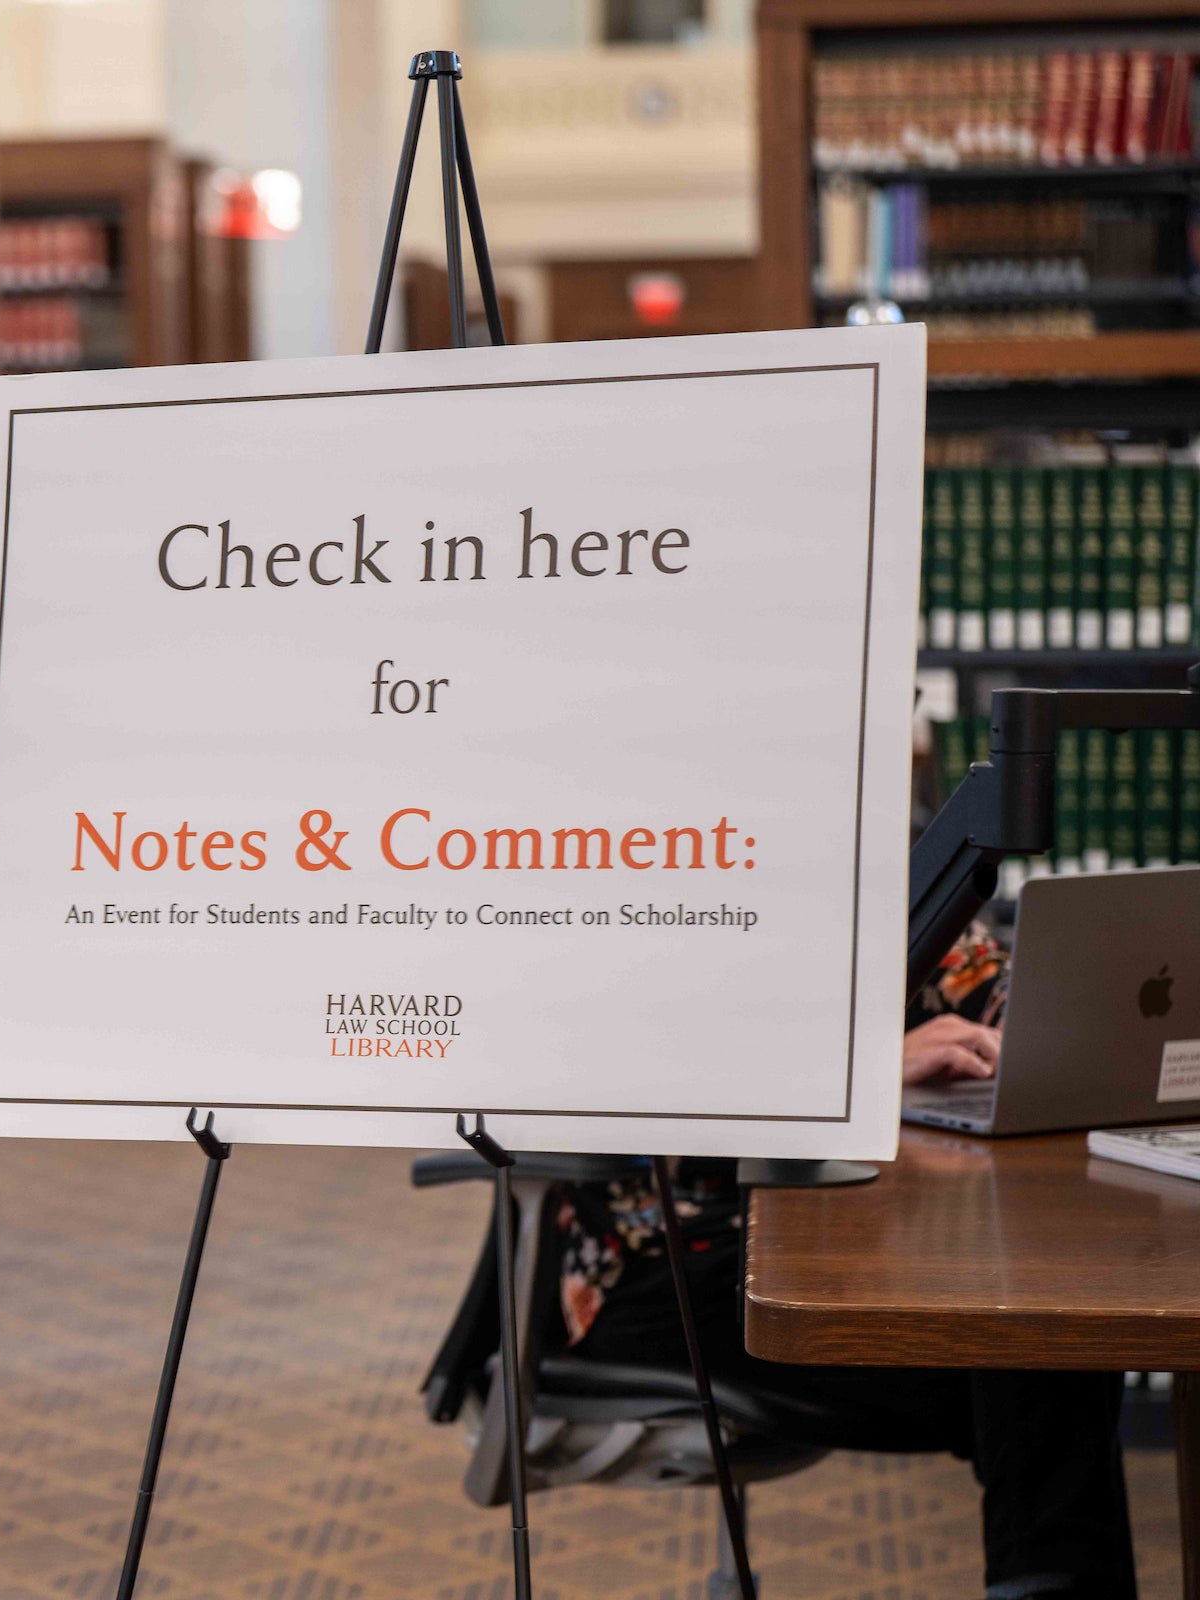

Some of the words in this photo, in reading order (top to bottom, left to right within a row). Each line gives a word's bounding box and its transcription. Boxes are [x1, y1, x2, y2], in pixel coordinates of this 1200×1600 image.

[157, 513, 393, 591] Check
[418, 520, 487, 583] in
[516, 506, 691, 579] here
[370, 659, 450, 715] for
[70, 811, 267, 872] Notes
[294, 809, 353, 872] &
[379, 807, 756, 871] Comment:
[64, 904, 95, 924] An
[102, 903, 162, 924] Event
[168, 902, 200, 925] for
[206, 903, 301, 925] Students
[307, 903, 349, 925] and
[356, 903, 438, 931] Faculty
[445, 907, 468, 925] to
[476, 903, 574, 926] Connect
[580, 909, 611, 926] on
[619, 903, 759, 932] Scholarship
[325, 993, 463, 1017] HARVARD
[325, 1018, 369, 1035] LAW
[375, 1019, 461, 1036] SCHOOL
[330, 1037, 454, 1059] LIBRARY
